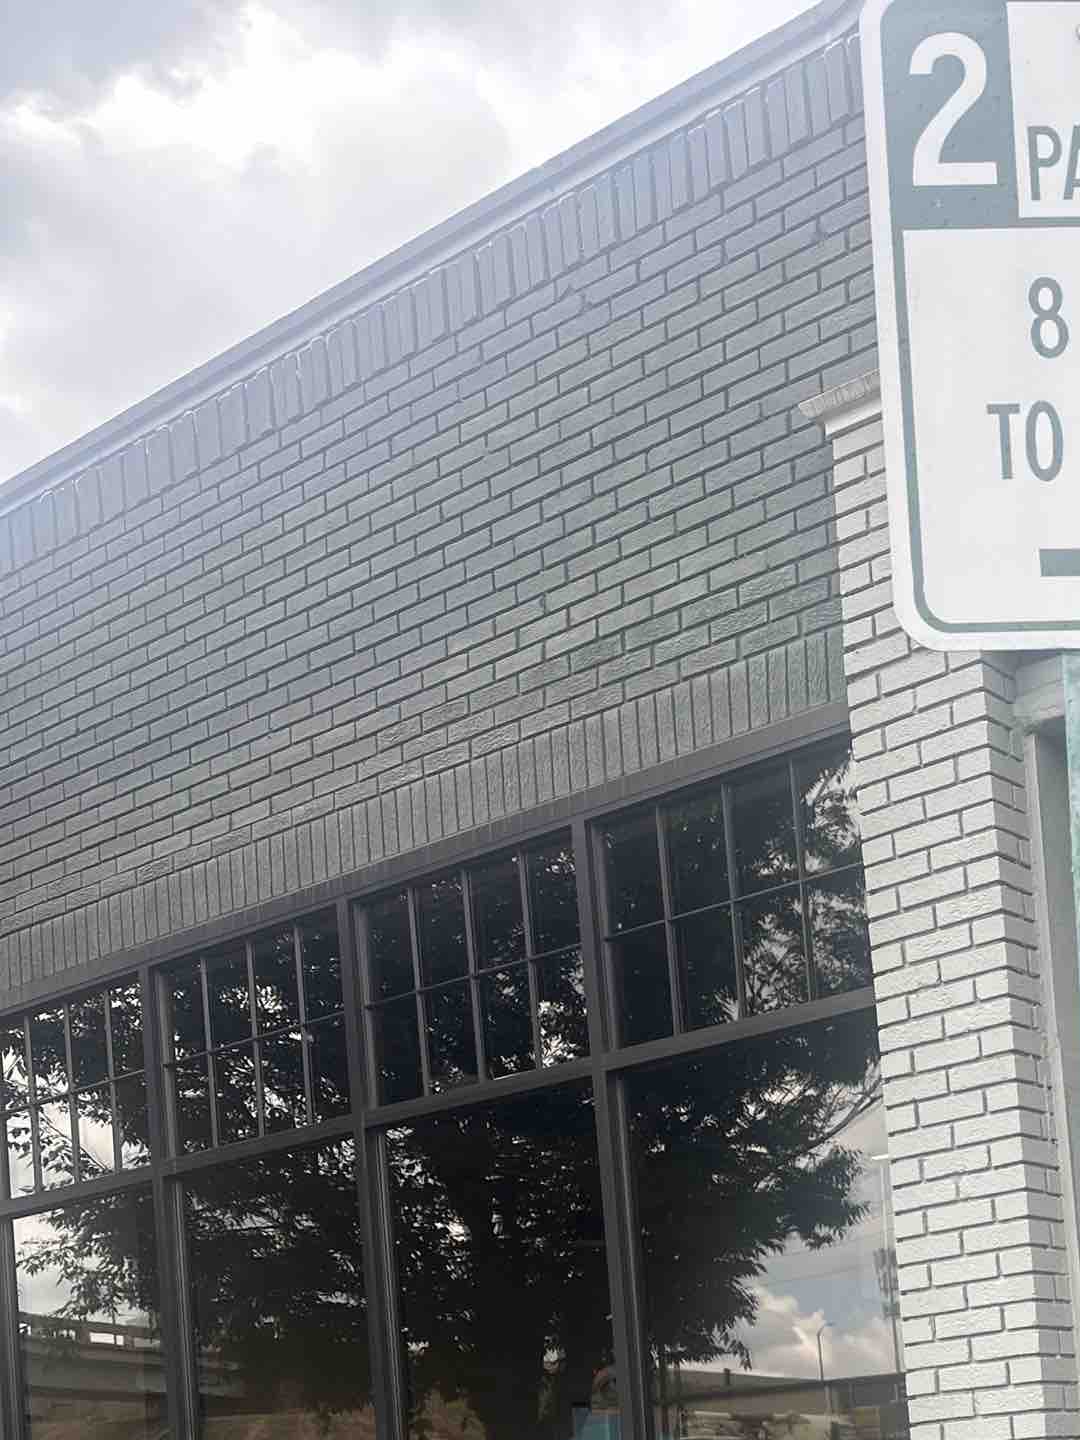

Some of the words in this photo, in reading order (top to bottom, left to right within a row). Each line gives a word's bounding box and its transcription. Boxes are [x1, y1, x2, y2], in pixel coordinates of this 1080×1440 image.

[909, 32, 997, 187] 2
[1027, 276, 1069, 360] 8
[986, 400, 1064, 482] TO
